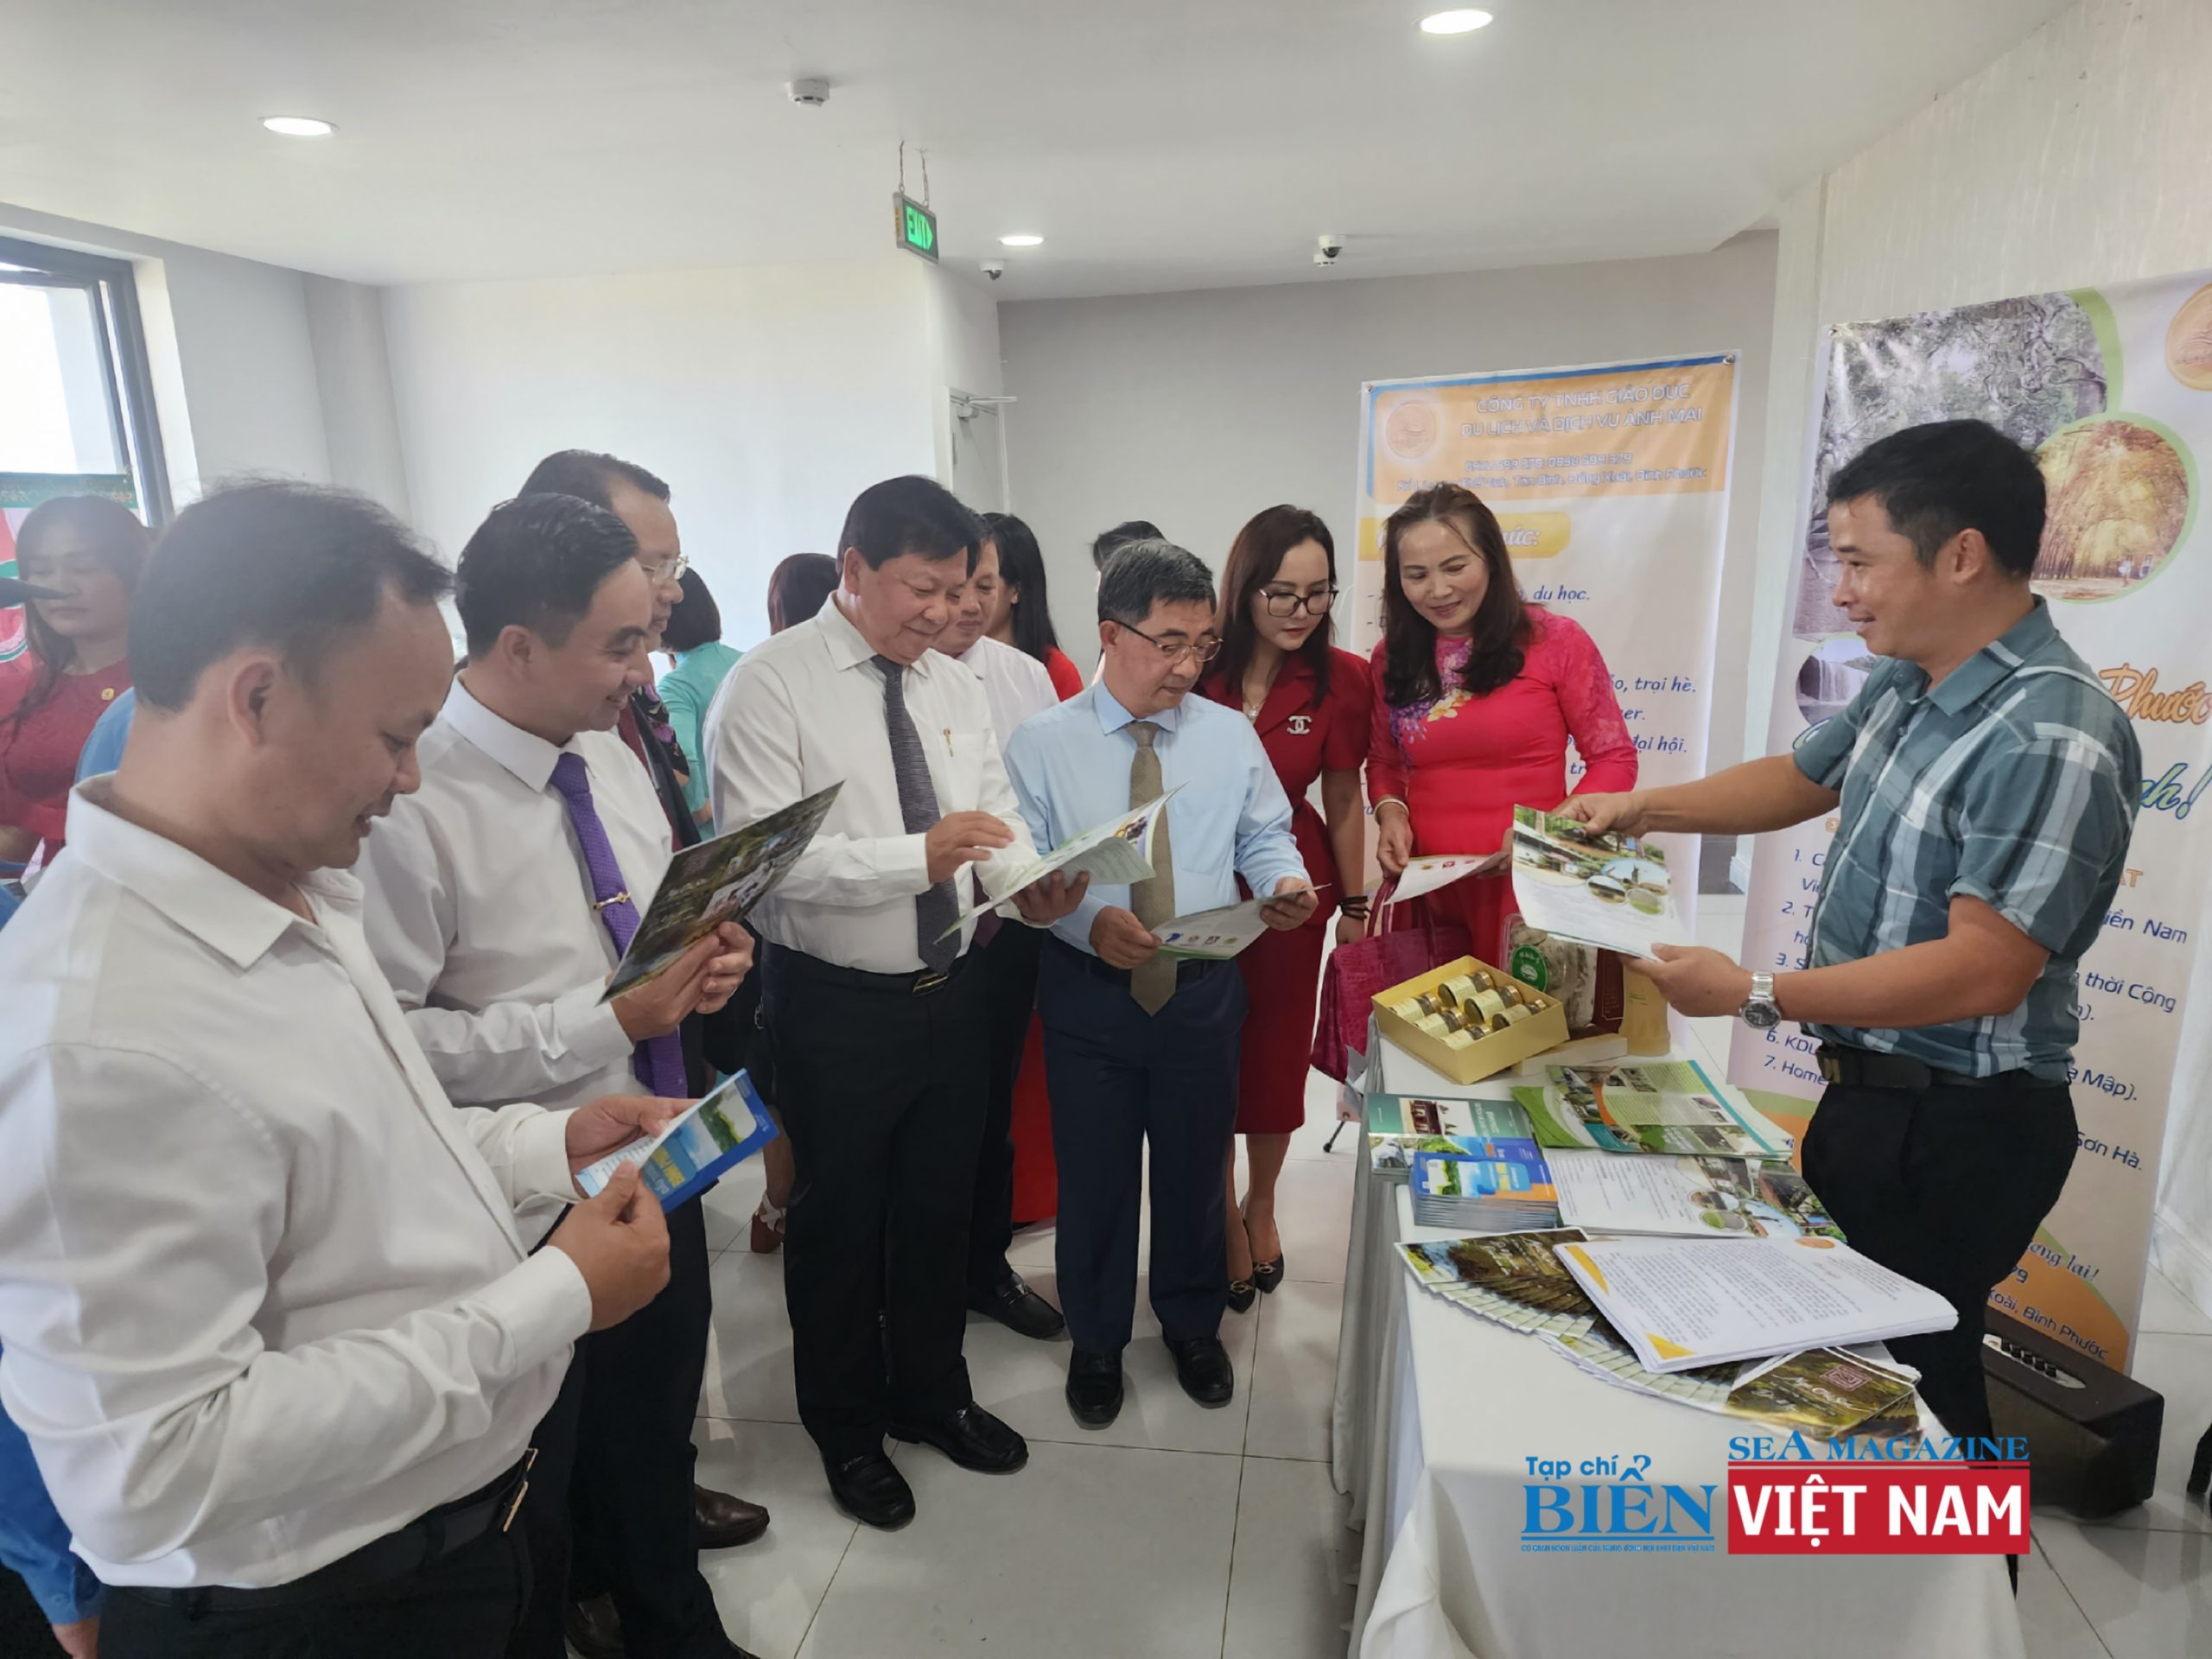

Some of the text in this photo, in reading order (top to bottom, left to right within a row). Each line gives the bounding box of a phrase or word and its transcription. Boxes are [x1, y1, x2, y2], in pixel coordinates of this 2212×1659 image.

[1477, 396, 1523, 412] CÔNG
[1529, 396, 1549, 409] TY
[1554, 391, 1602, 408] TNHH
[1606, 385, 1648, 404] GIÁO
[1460, 423, 1484, 436] DU
[1525, 415, 1550, 433] VÀ
[1553, 415, 1593, 433] DỊCH
[1667, 407, 1702, 424] MAI
[1534, 586, 1553, 601] du
[1557, 584, 1591, 603] học.
[1635, 677, 1667, 694] trại
[1670, 676, 1696, 693] hè.
[1657, 735, 1687, 754] hội.
[2143, 918, 2188, 944] Nam
[2085, 971, 2177, 1014] thời Cộng
[1764, 1054, 1777, 1070] 7.
[2082, 1068, 2138, 1101] Mập).
[2112, 1145, 2142, 1171] Hà.
[2066, 1254, 2100, 1282] lai!
[2023, 1306, 2057, 1332] Bình
[2059, 1324, 2109, 1360] Phước
